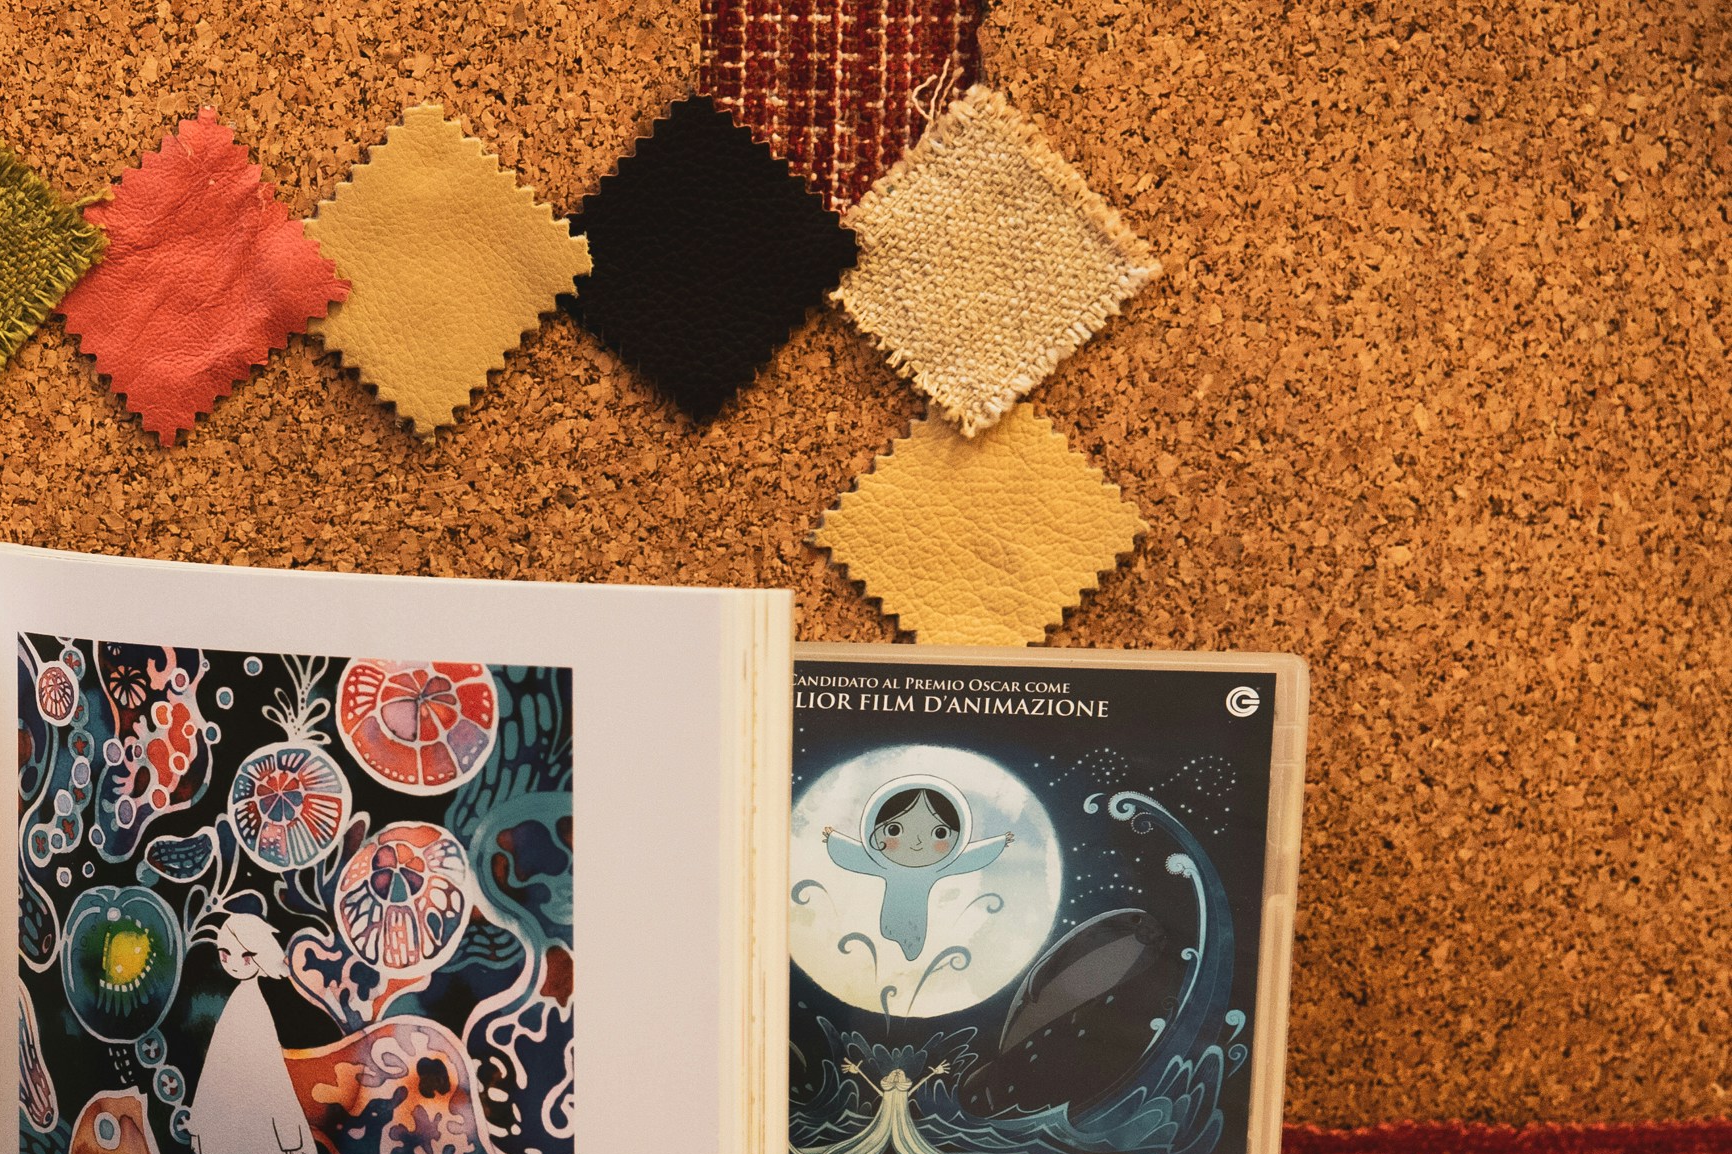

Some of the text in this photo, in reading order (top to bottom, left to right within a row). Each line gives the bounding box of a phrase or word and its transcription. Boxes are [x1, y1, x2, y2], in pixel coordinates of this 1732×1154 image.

[882, 678, 900, 689] AL
[905, 677, 964, 691] PREMIO
[968, 678, 1021, 692] OSCAR
[1024, 682, 1070, 693] COME
[795, 692, 1109, 718] LIOR FILM D'ANIMAZIONE
